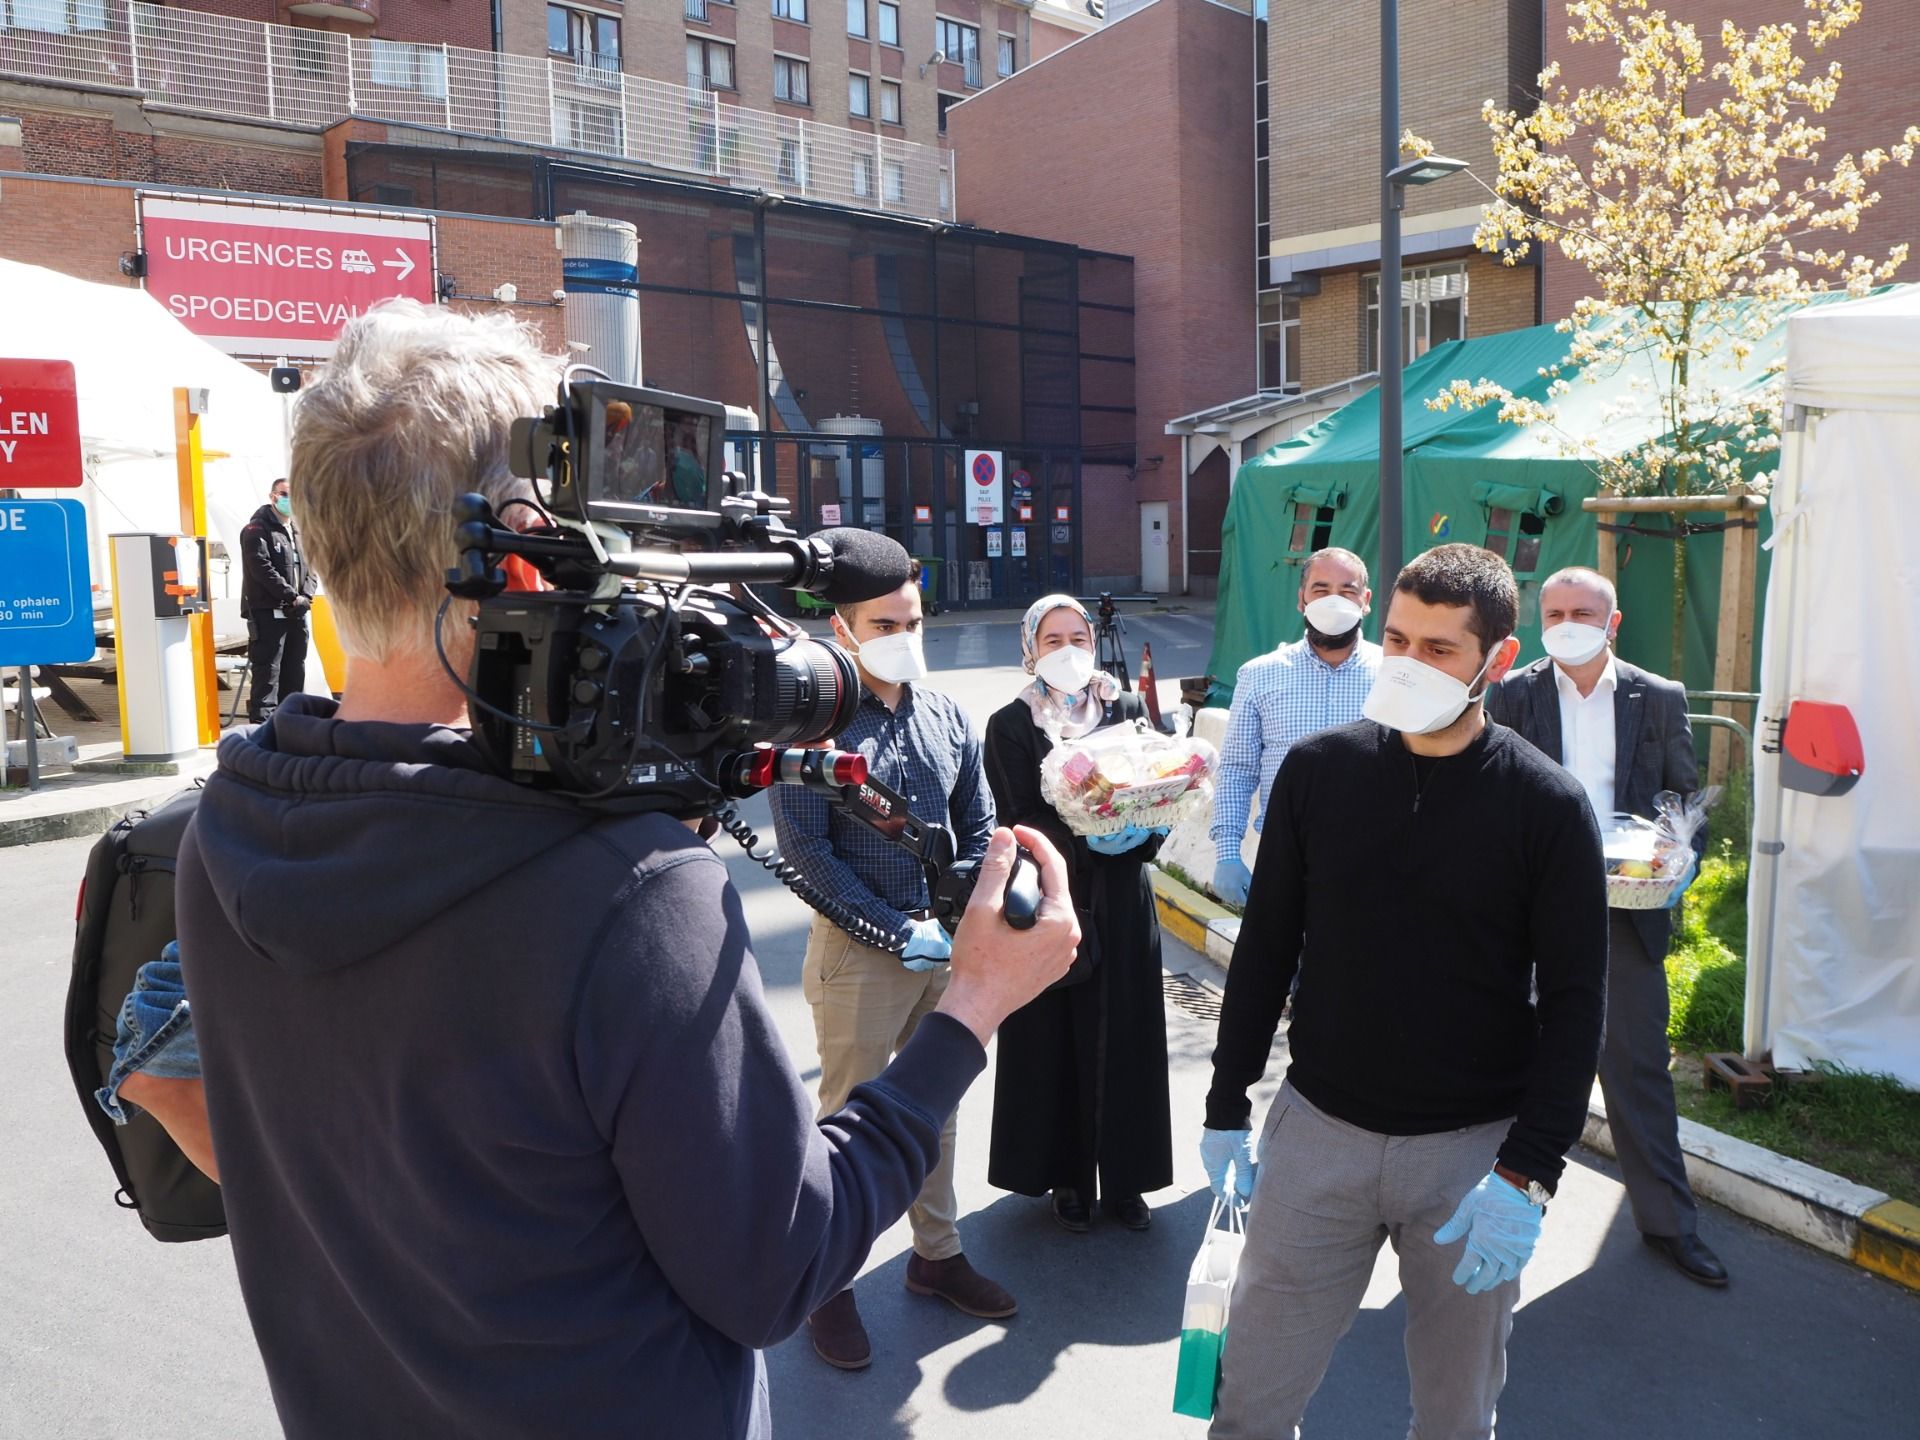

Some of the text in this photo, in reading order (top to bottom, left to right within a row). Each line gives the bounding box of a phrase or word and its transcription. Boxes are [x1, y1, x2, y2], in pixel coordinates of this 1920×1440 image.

[165, 236, 333, 270] URGENCES
[168, 294, 372, 325] SPOEDGEVAL
[13, 597, 60, 608] ophalen
[21, 610, 43, 619] min
[860, 783, 892, 815] SHAPE
